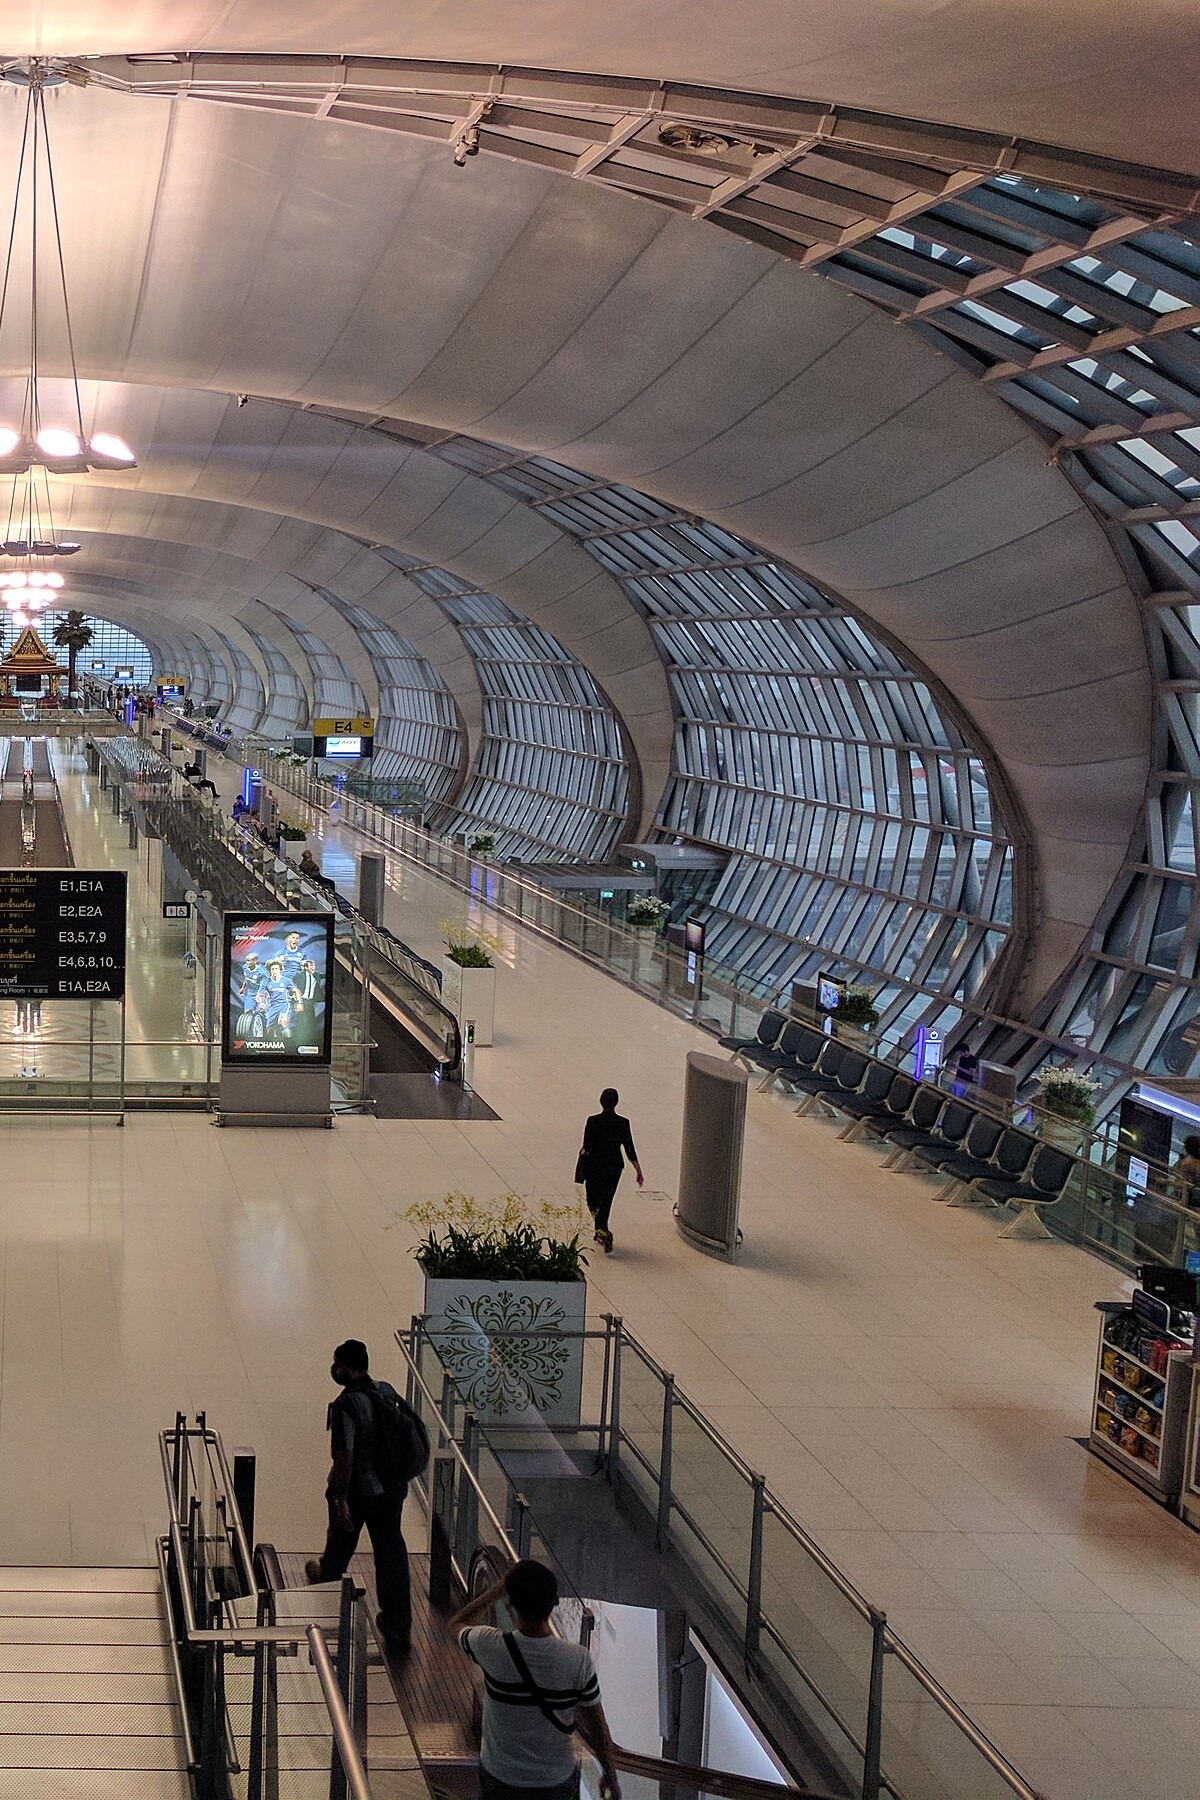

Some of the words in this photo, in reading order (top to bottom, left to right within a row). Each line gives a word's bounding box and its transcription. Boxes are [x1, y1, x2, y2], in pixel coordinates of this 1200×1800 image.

[334, 721, 353, 733] E4
[60, 880, 104, 893] E1,E1A
[59, 905, 103, 918] E2,E2A
[58, 931, 107, 944] E3,5,7,9
[58, 980, 111, 993] E1A,E2A
[245, 1041, 286, 1049] YOKOHAMA
